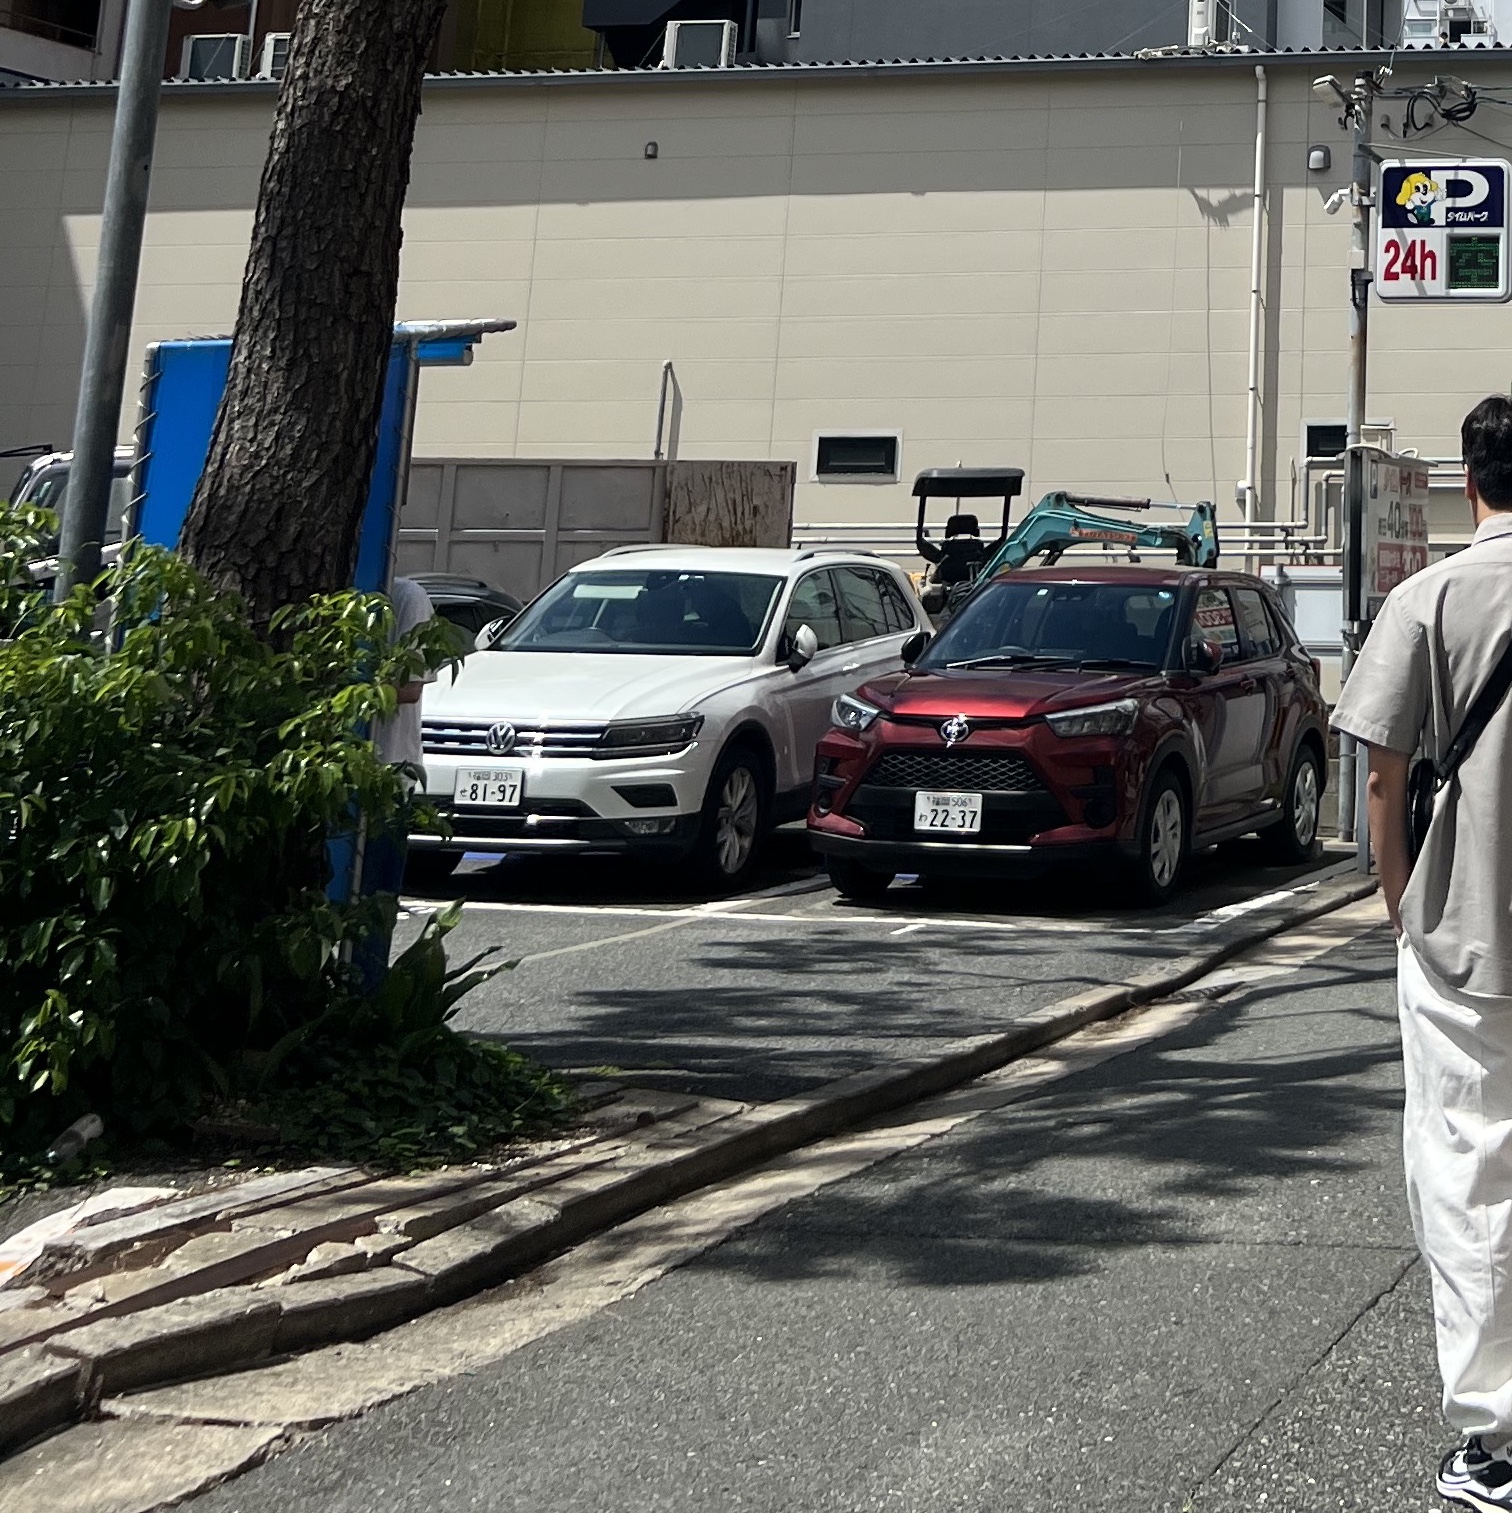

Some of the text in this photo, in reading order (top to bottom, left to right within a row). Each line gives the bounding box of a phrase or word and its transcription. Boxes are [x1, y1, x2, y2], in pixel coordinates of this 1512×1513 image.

[1430, 170, 1490, 226] P
[1447, 211, 1489, 222] タイムパーク
[1383, 239, 1437, 281] 24h
[470, 783, 518, 802] 81-97
[929, 809, 978, 829] 22-37
